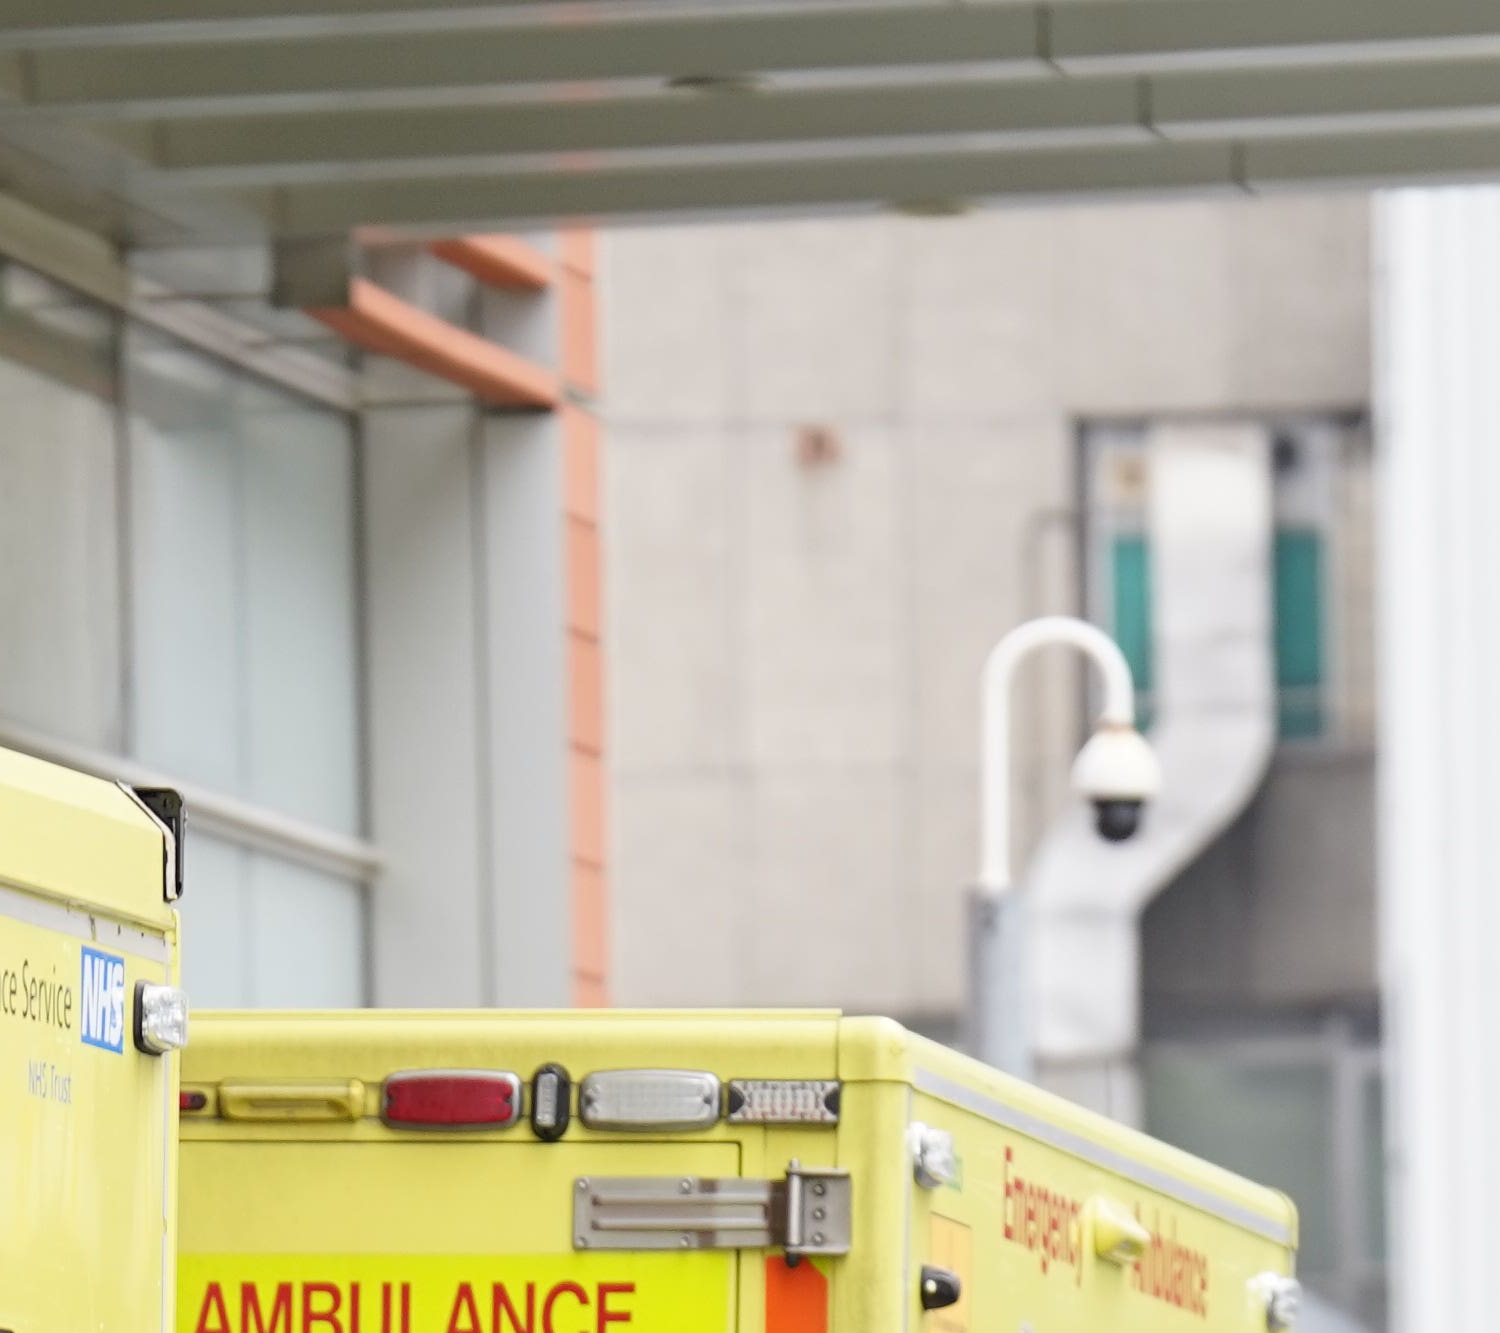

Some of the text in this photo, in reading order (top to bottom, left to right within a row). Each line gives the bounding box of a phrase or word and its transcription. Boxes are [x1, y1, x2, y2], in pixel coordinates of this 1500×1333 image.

[21, 956, 73, 1030] Service
[83, 952, 124, 1052] NHS
[27, 1059, 73, 1105] NHS Trust
[1003, 1145, 1084, 1290] Emergency
